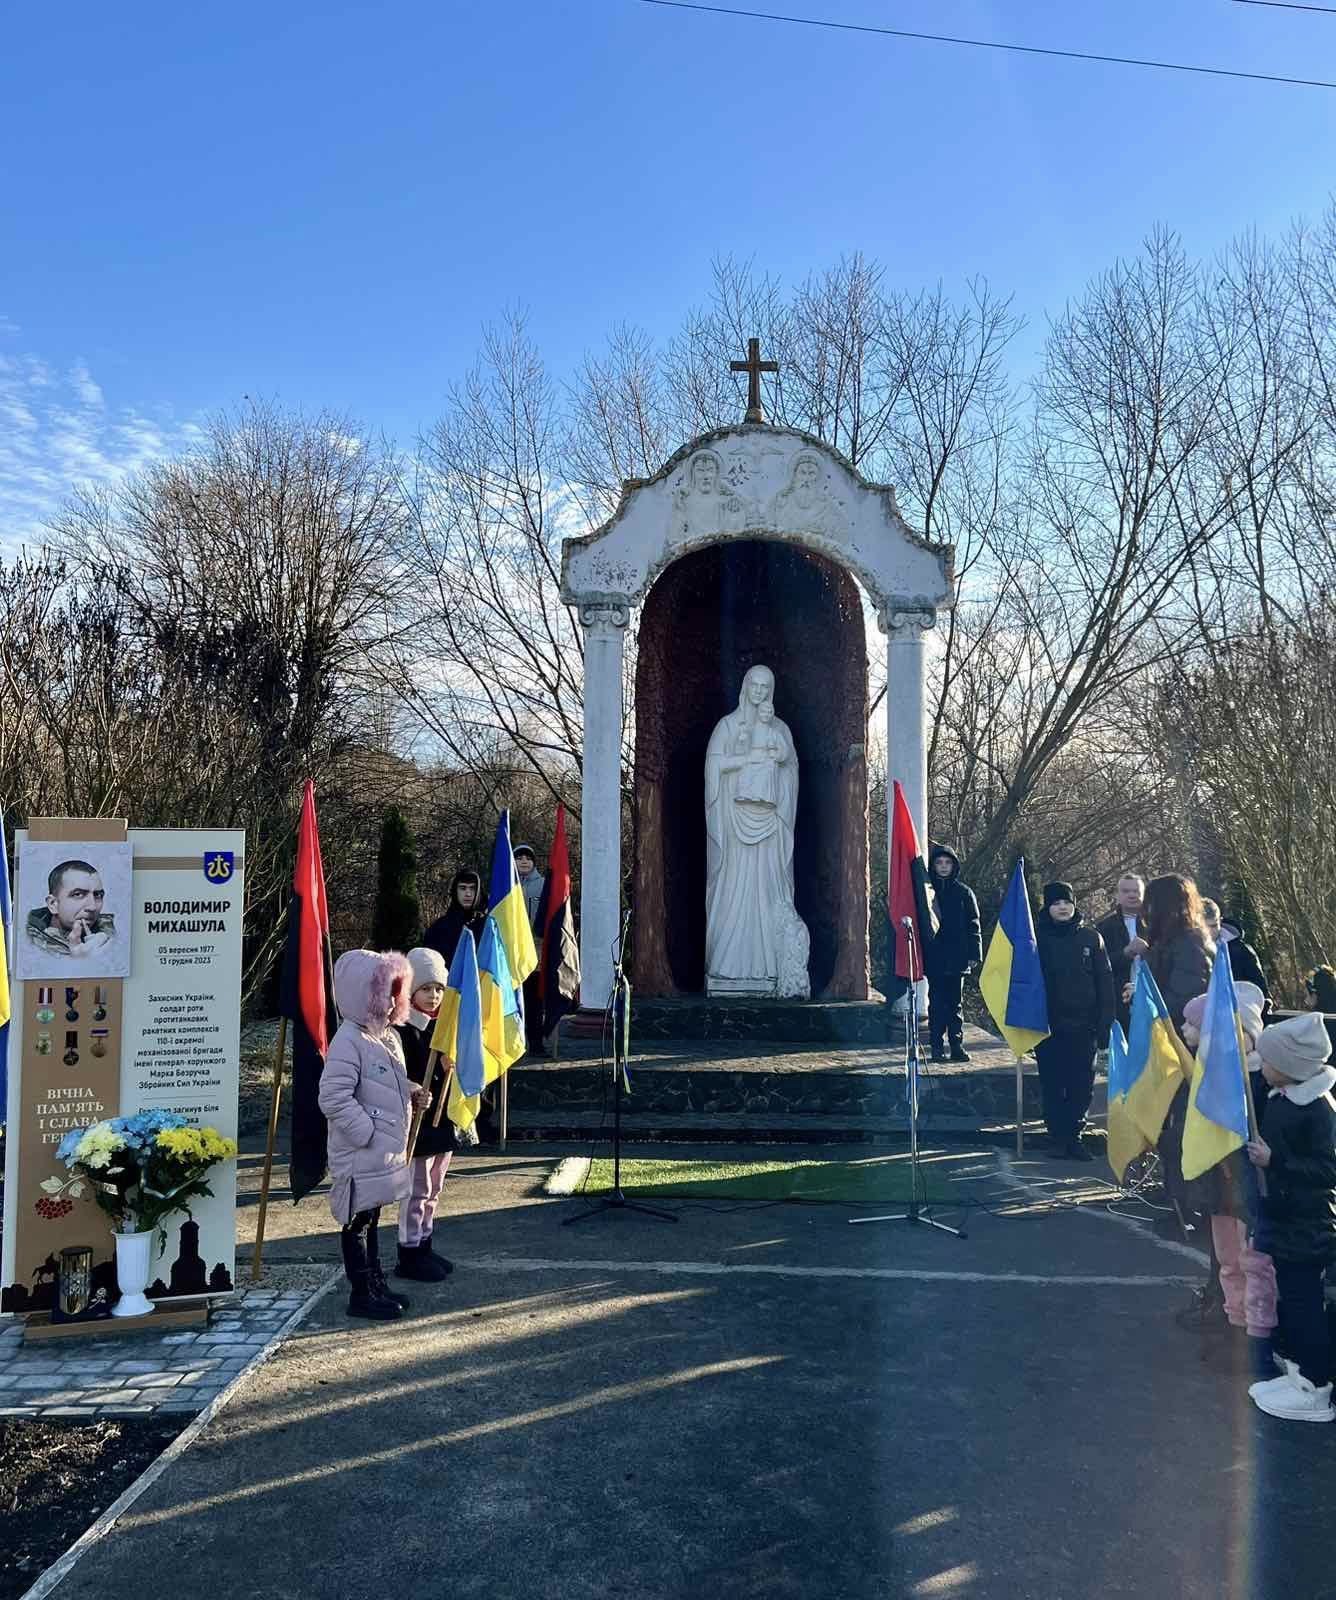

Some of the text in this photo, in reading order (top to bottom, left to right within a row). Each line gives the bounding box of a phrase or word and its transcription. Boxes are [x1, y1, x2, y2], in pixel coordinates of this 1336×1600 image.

[144, 901, 231, 915] ВОЛОДИМИР
[148, 920, 226, 933] МИХАШУЛА
[200, 945, 215, 953] 1977
[168, 958, 193, 967] грудня
[148, 994, 183, 1002] Захисник
[153, 1016, 208, 1024] протитанкових
[142, 1027, 177, 1036] ракетних
[193, 1046, 223, 1054] бригади
[150, 1070, 174, 1078] Марка
[192, 1079, 221, 1088] України
[47, 1088, 94, 1099] ВІЧНА
[173, 1106, 202, 1114] загинув
[203, 1104, 219, 1112] біля
[39, 1116, 98, 1129] І СЛАВА
